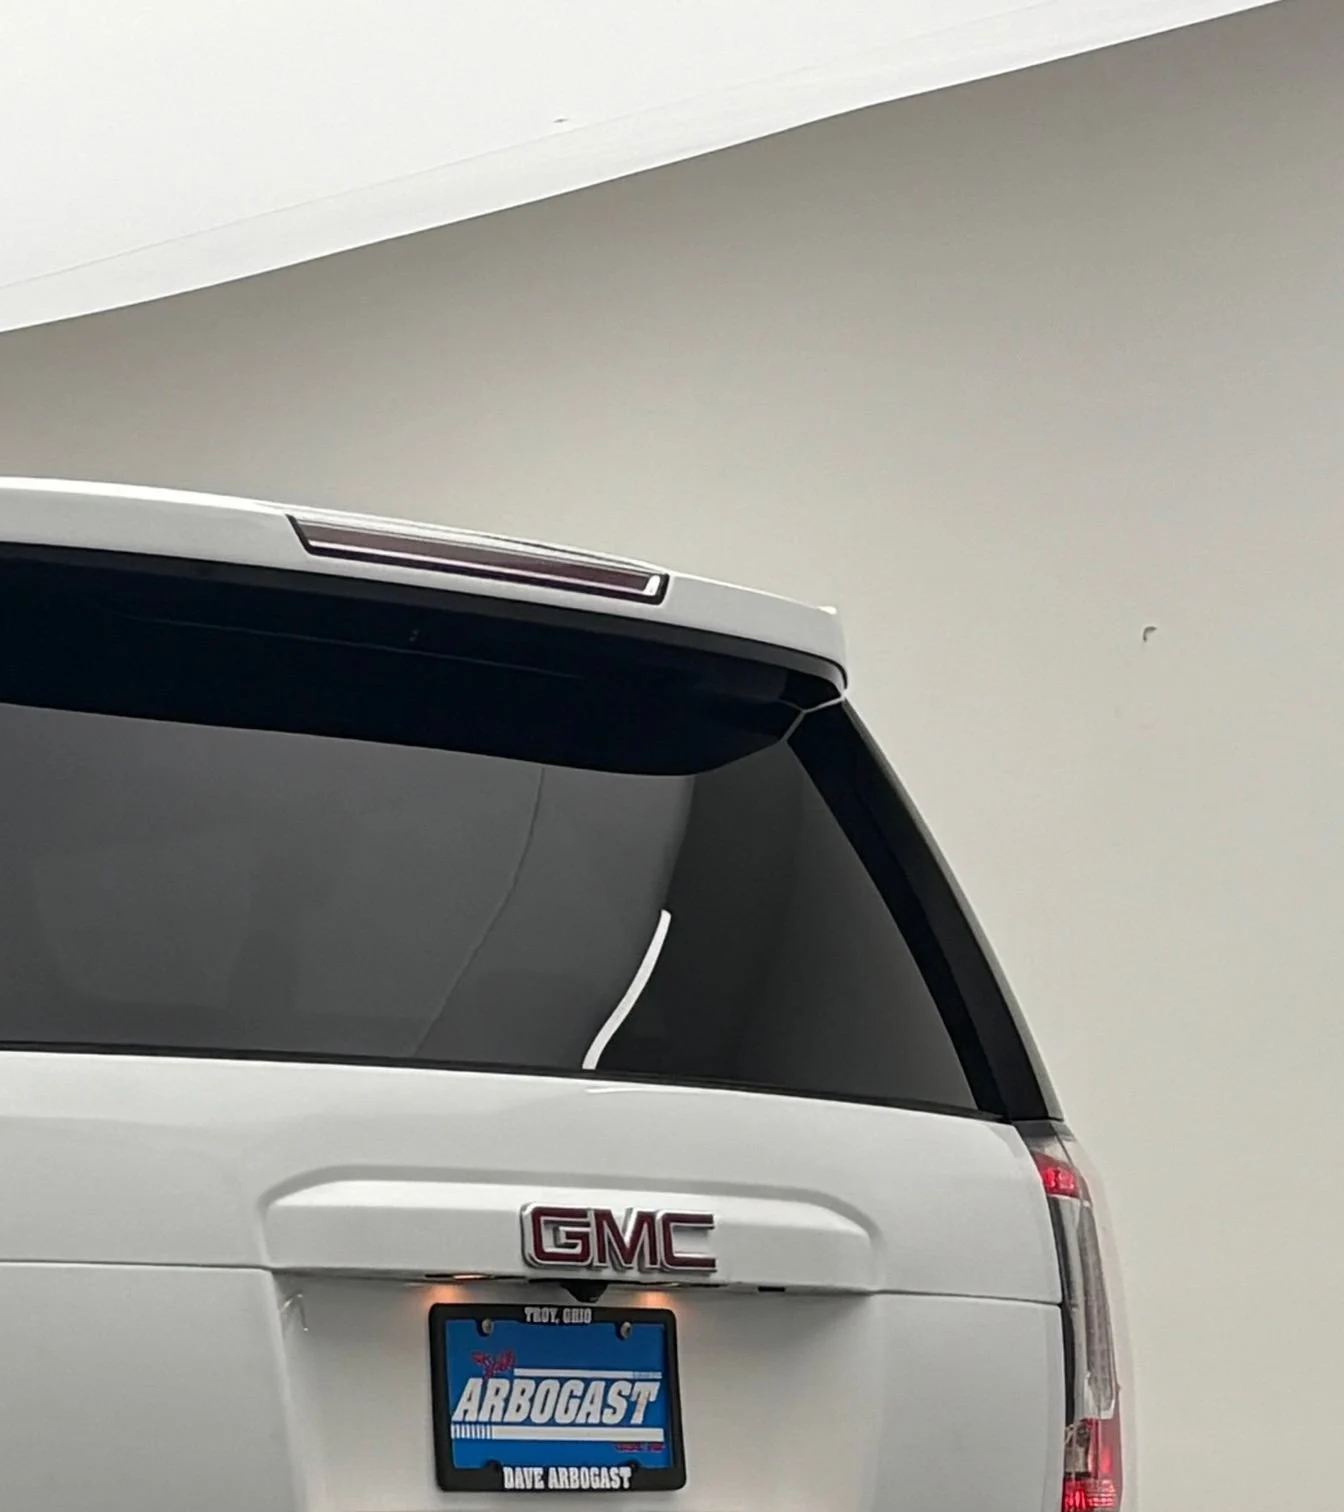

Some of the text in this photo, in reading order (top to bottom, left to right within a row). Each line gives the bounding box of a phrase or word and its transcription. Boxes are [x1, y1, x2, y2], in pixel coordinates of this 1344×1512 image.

[521, 1202, 717, 1273] GMC
[451, 1376, 661, 1425] ARBOGAST
[502, 1466, 633, 1490] DAVE ARBOGAST
